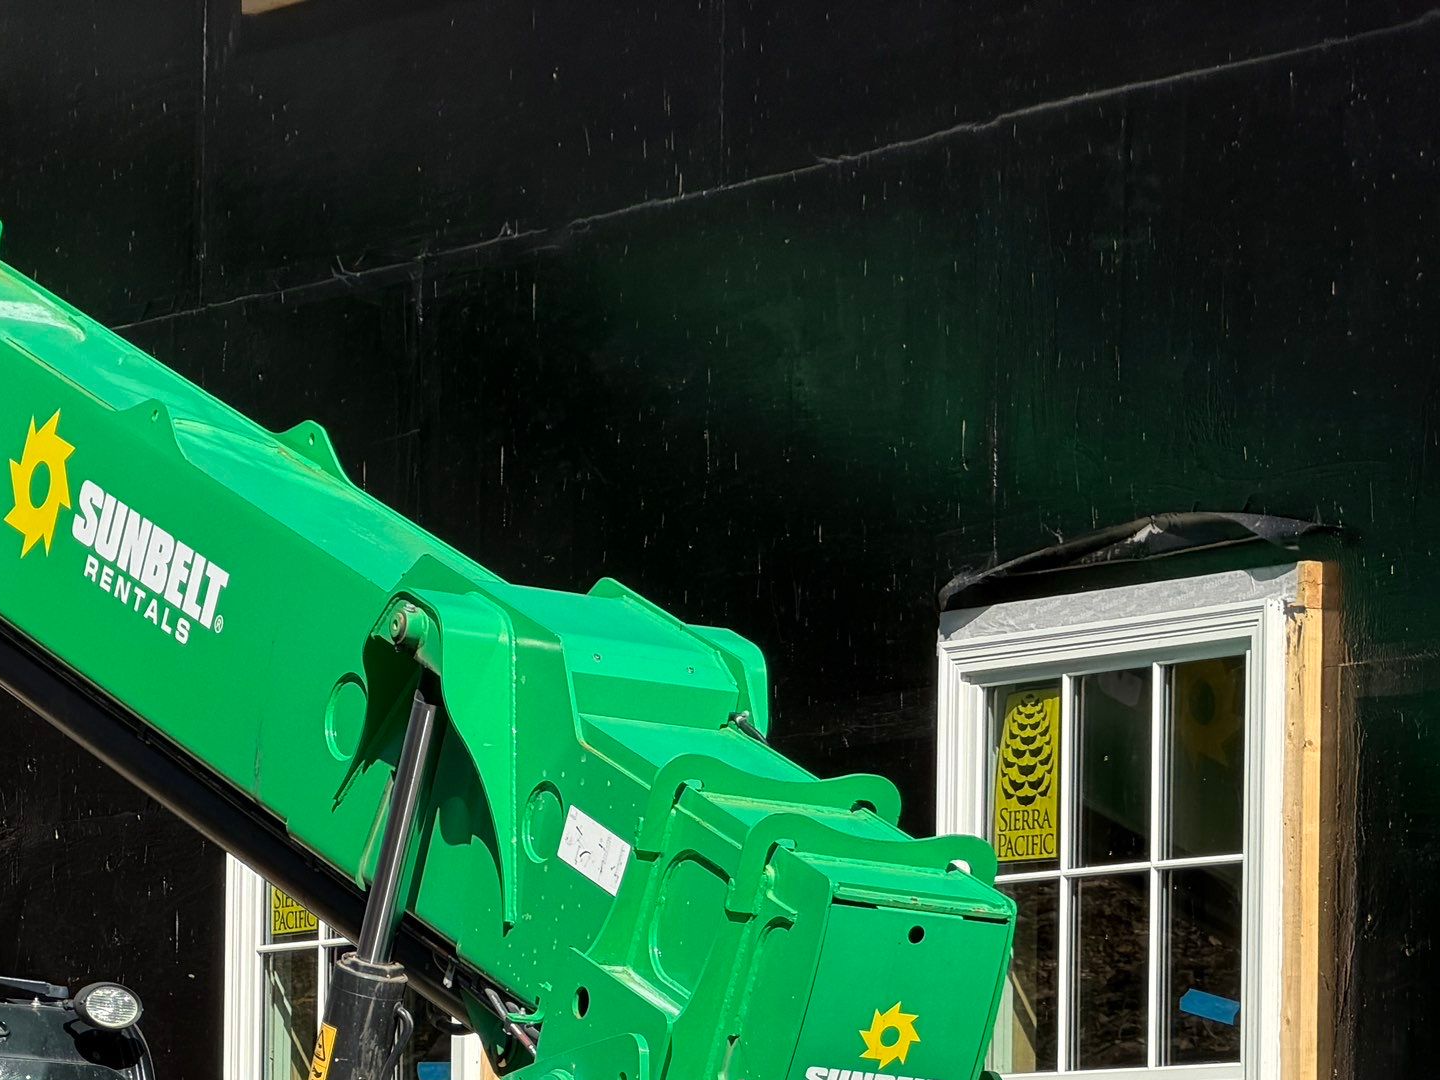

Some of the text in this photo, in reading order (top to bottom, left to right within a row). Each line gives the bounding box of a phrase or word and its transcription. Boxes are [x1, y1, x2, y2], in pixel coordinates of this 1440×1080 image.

[72, 479, 230, 630] SUNBELT
[83, 553, 191, 645] RENTALS
[997, 832, 1055, 858] PACIFIC
[998, 807, 1053, 833] SIERRA
